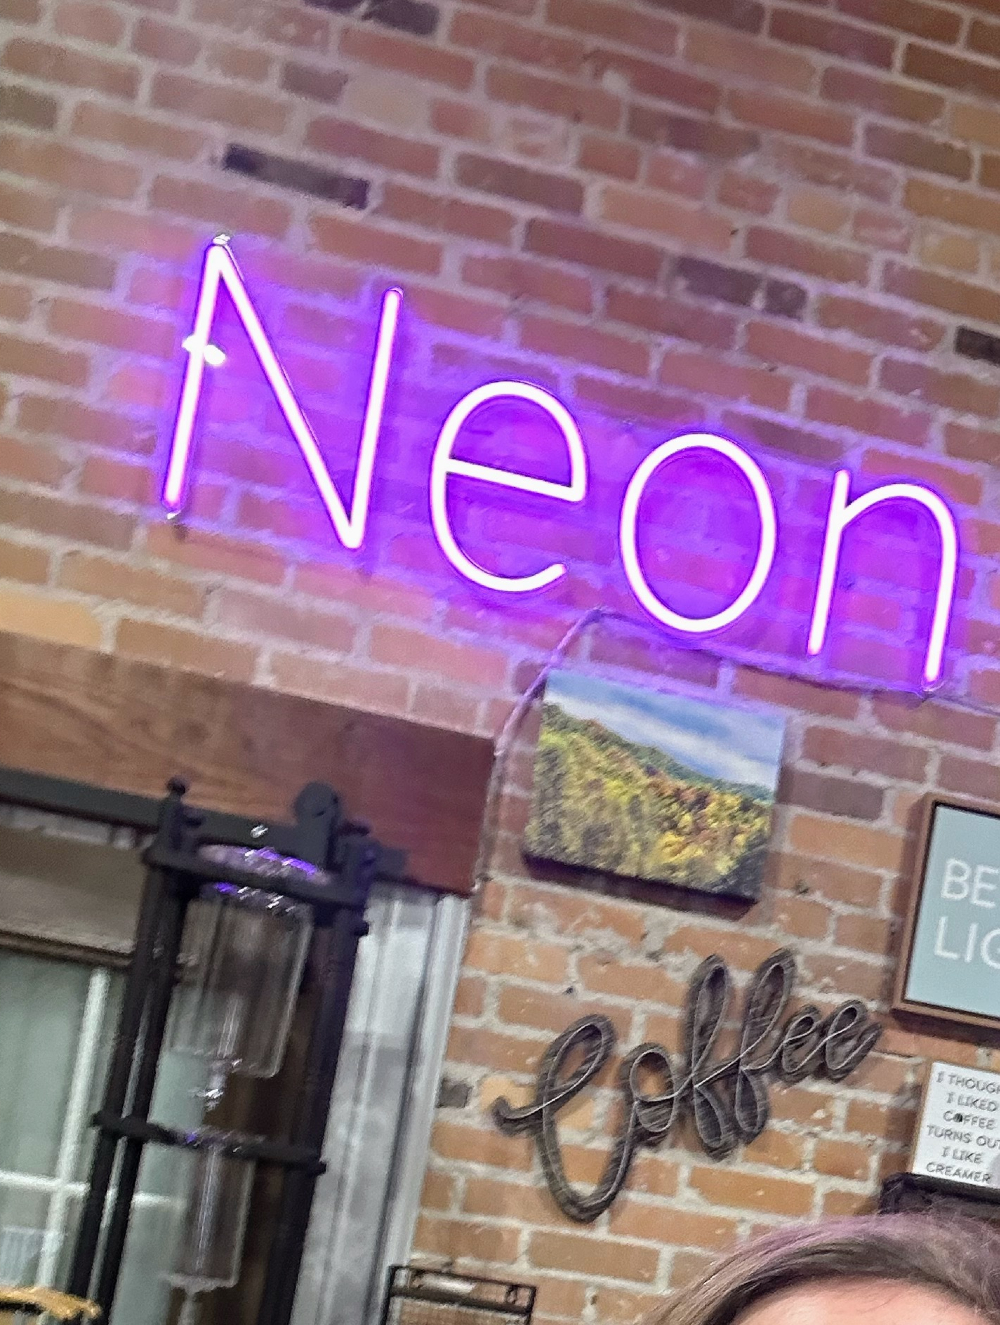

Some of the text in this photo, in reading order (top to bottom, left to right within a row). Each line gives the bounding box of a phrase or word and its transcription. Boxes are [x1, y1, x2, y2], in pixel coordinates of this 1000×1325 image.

[161, 236, 958, 688] Neon
[940, 857, 1000, 910] BE
[491, 948, 882, 1223] Coffee
[936, 1071, 945, 1083] I
[946, 1091, 998, 1112] I LIKED
[943, 1110, 997, 1130] COFFEE
[926, 1124, 972, 1144] TURNS
[941, 1146, 984, 1164] I LIKE
[926, 1161, 992, 1183] CREAMER
